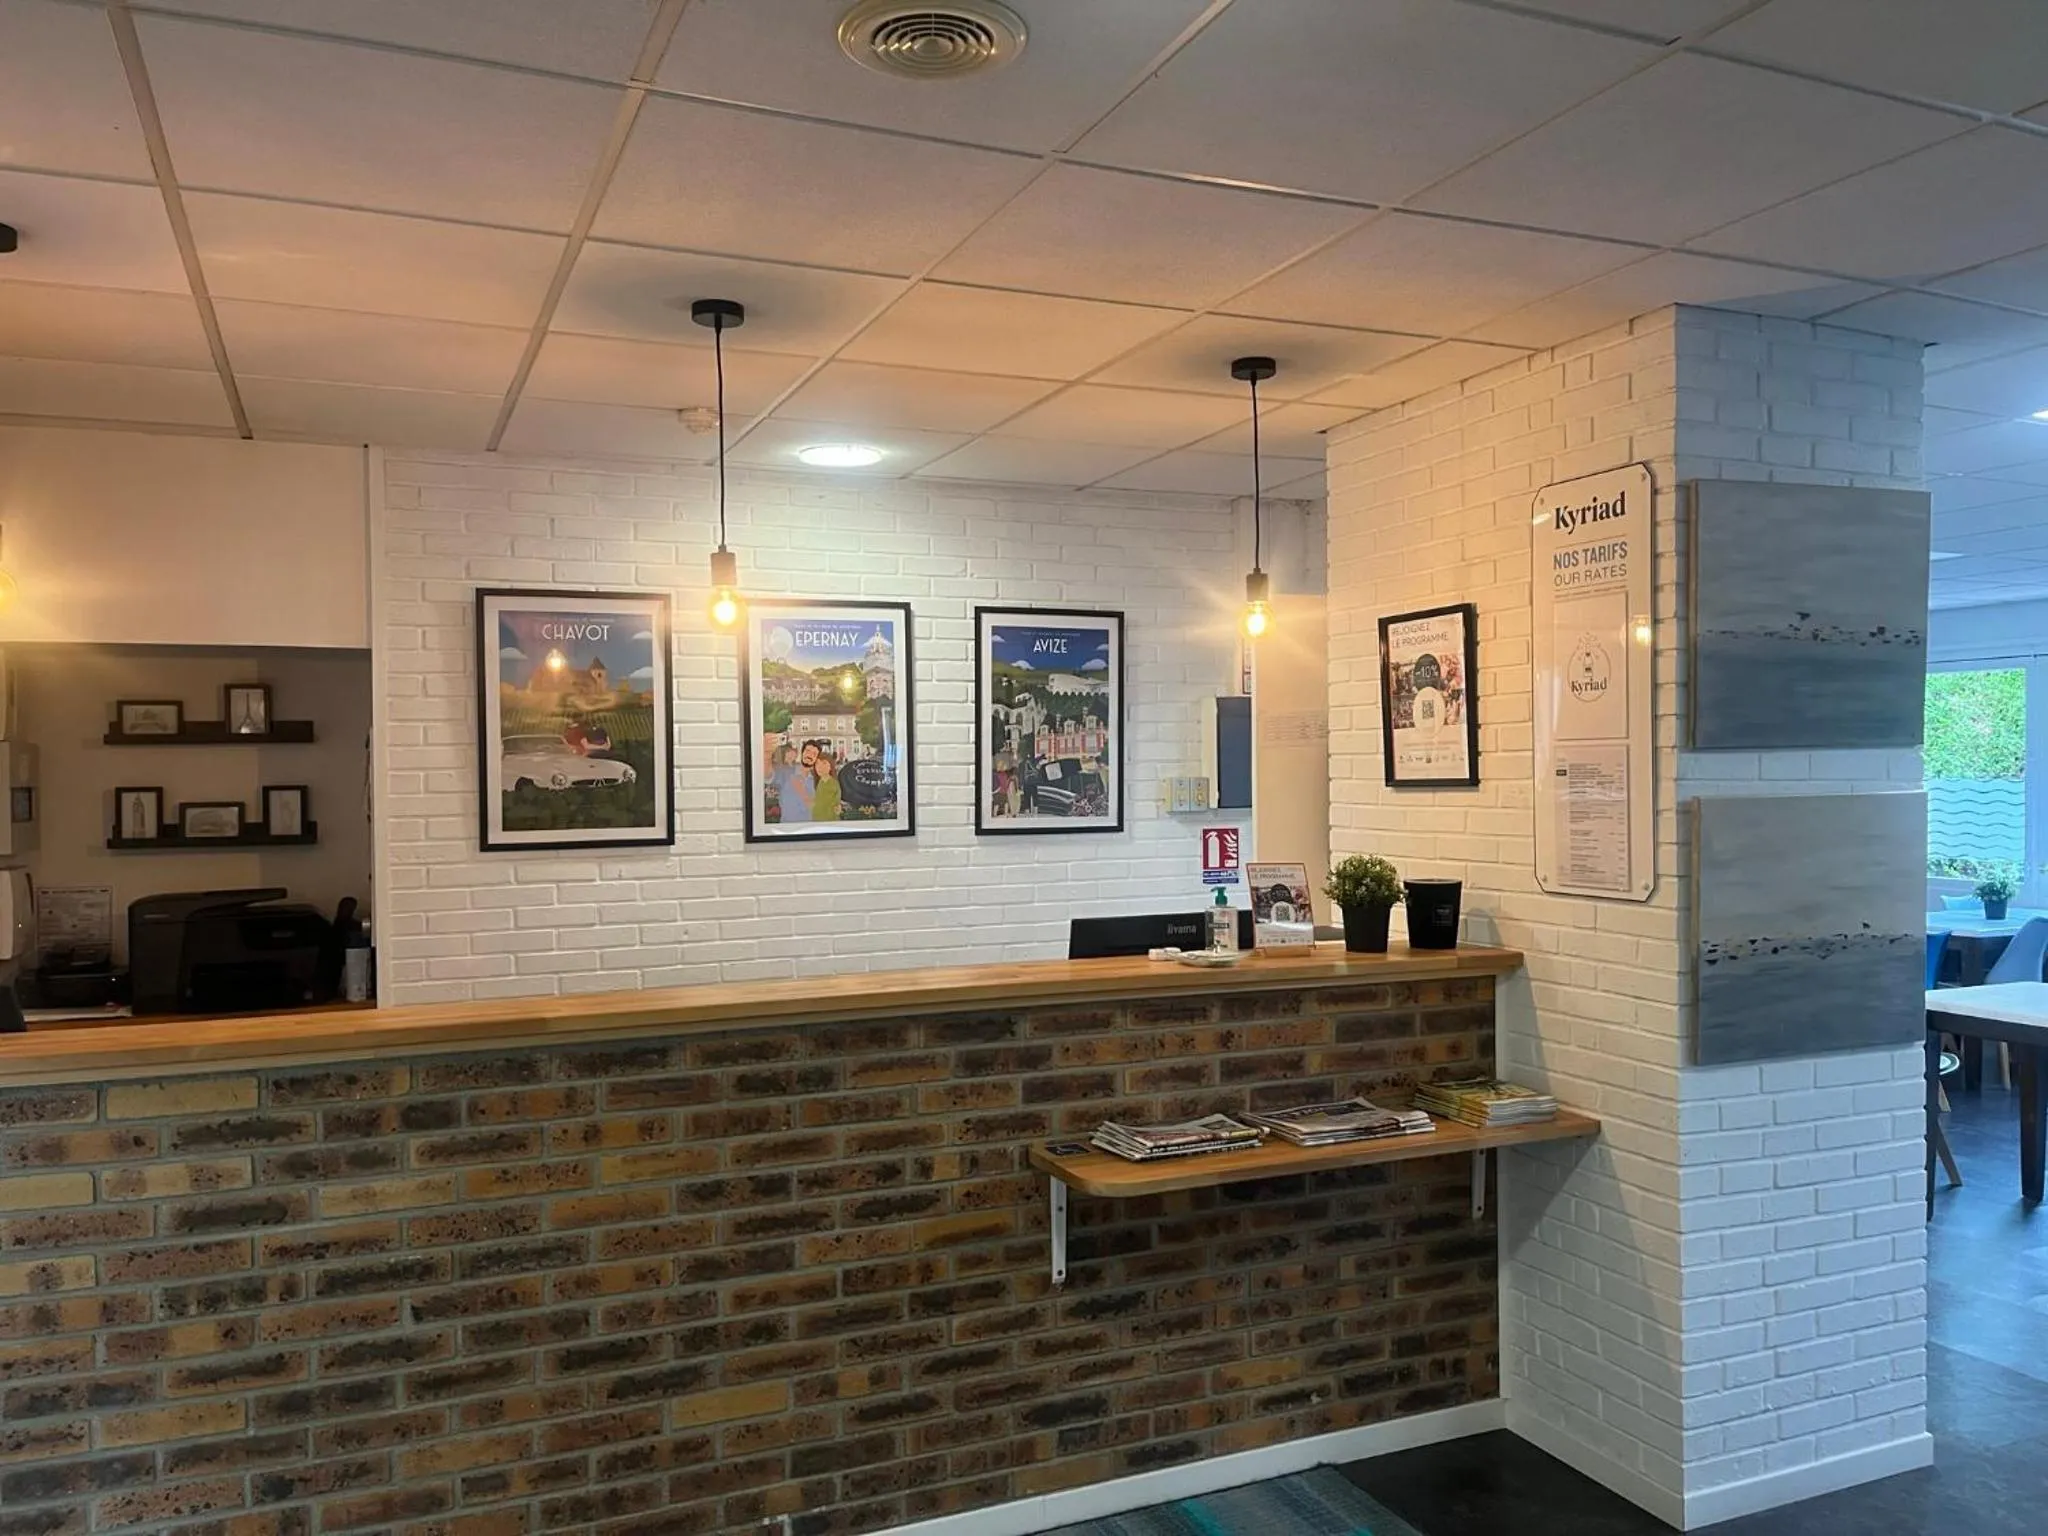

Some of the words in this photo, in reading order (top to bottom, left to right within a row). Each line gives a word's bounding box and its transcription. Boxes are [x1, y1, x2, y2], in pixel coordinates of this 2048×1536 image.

[1555, 490, 1626, 535] Kyriad
[1553, 550, 1579, 570] NOS
[1582, 541, 1628, 565] TARIFS
[1554, 571, 1580, 587] OUR
[1584, 563, 1627, 582] RATES
[542, 623, 610, 641] CHAVOT
[795, 631, 858, 648] EPERNAY
[1033, 638, 1068, 654] AVIZE
[1570, 677, 1607, 696] Kyriad
